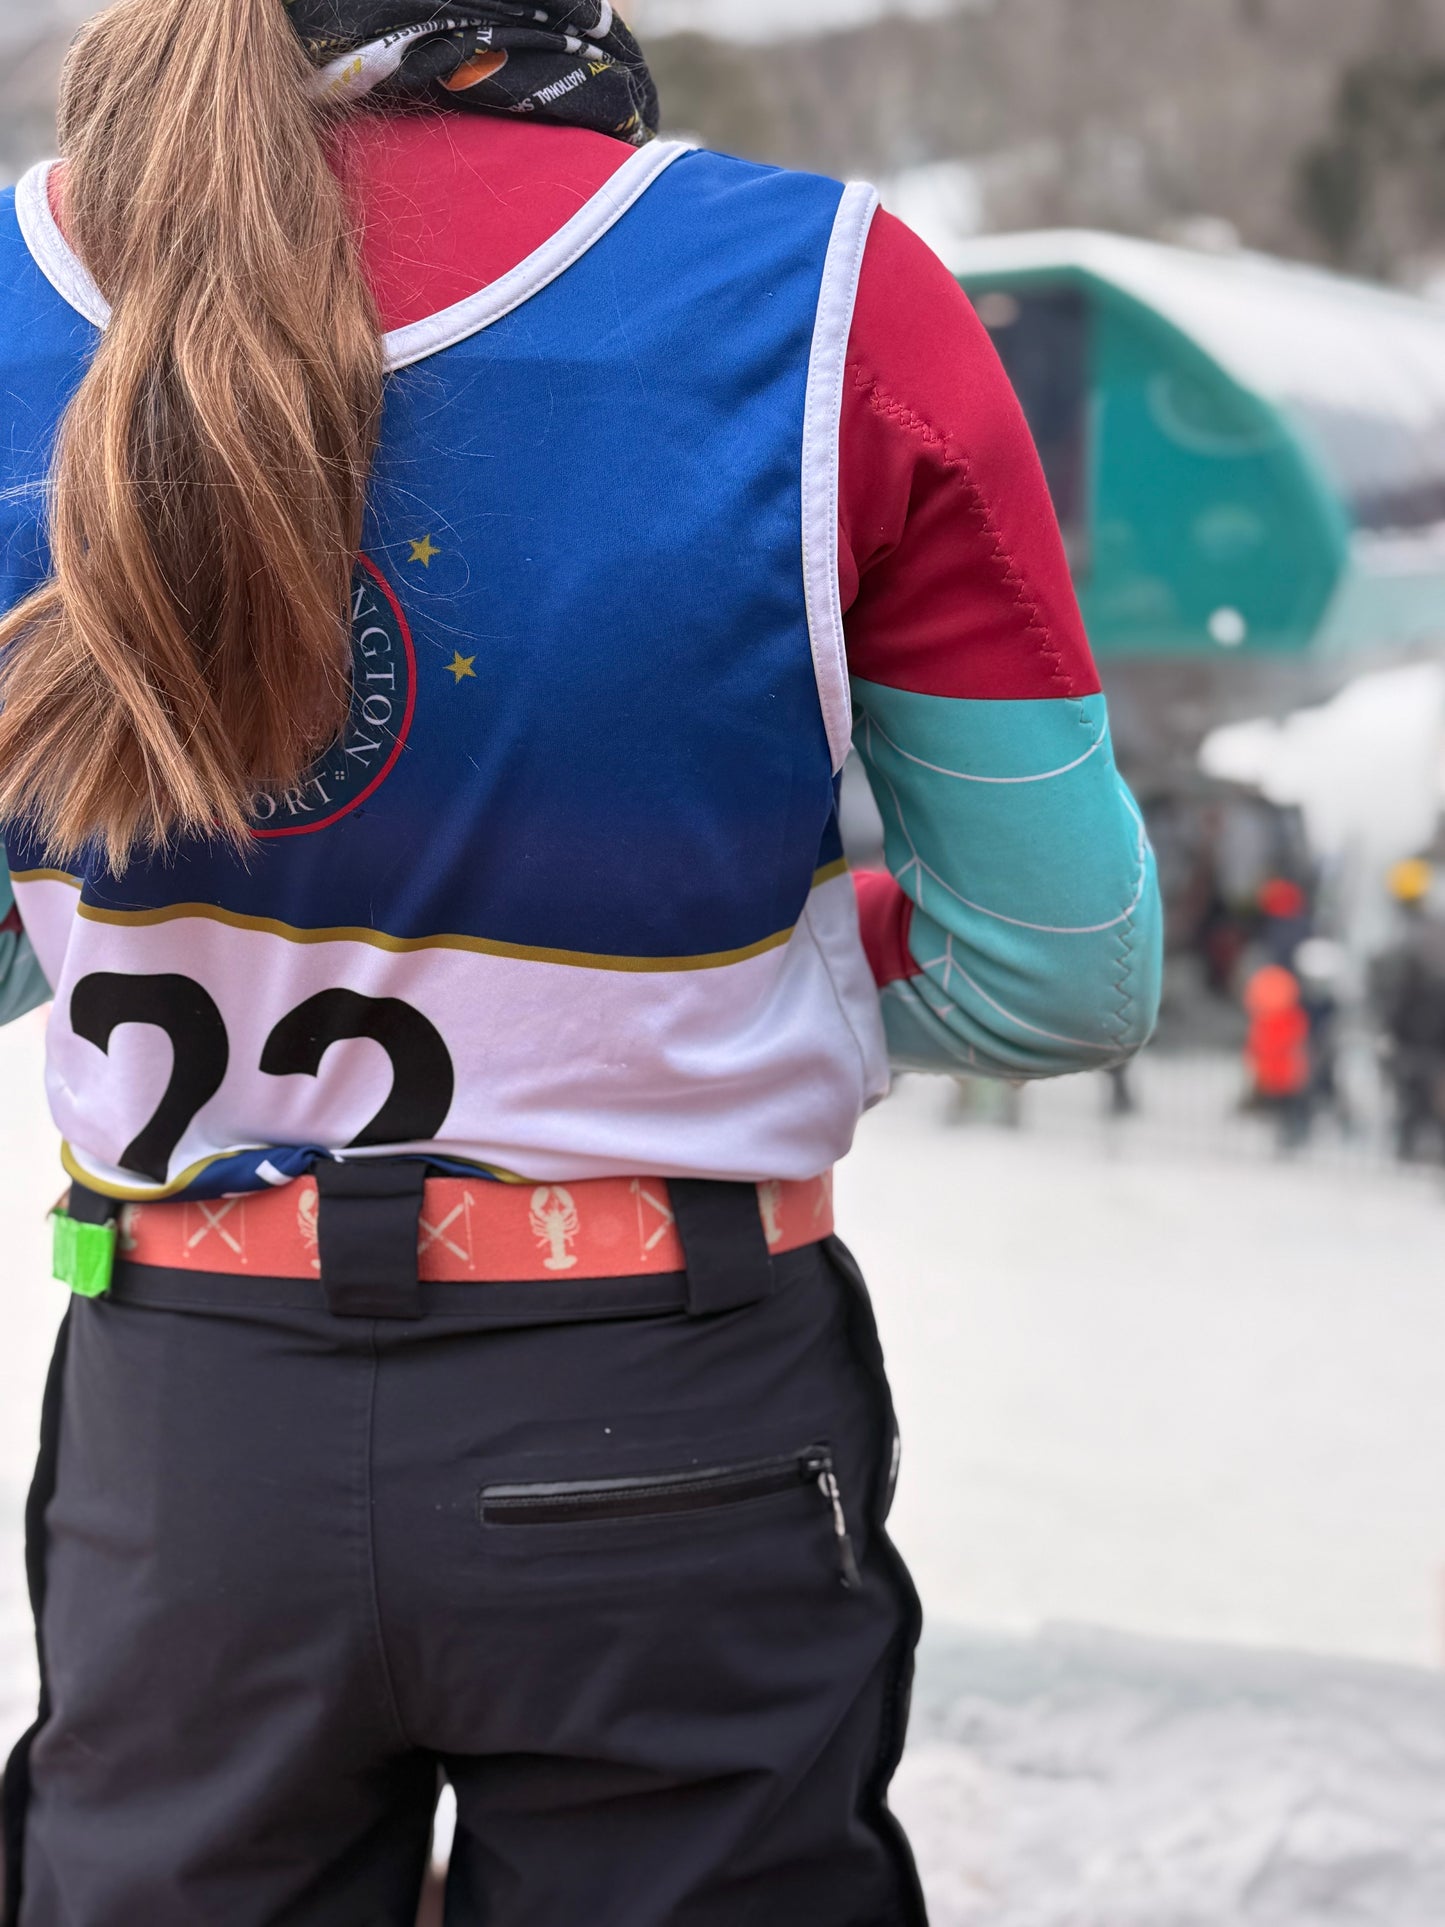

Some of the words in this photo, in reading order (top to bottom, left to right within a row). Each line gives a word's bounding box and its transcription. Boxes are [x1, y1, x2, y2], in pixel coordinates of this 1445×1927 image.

[533, 68, 587, 104] NATIONAL
[346, 584, 395, 767] NGTON
[249, 771, 334, 820] ORT
[70, 972, 454, 1185] 22
